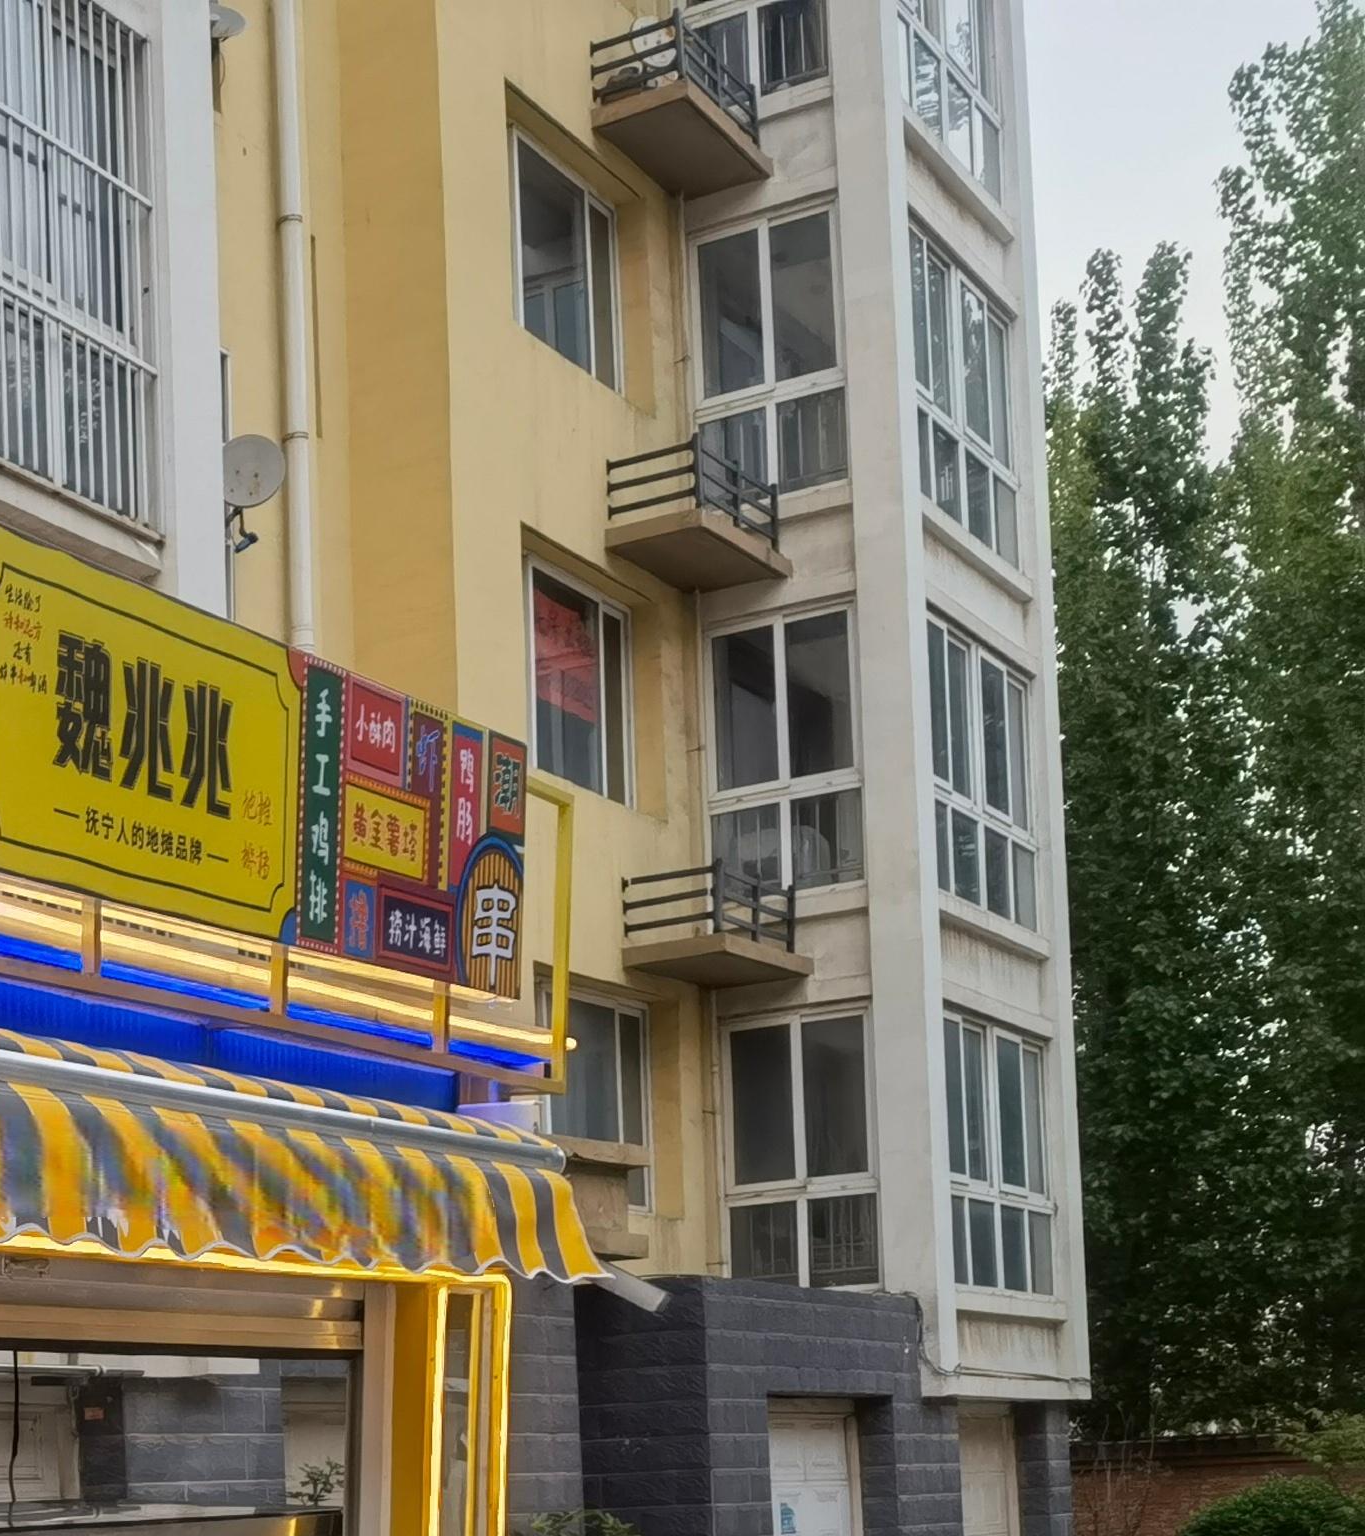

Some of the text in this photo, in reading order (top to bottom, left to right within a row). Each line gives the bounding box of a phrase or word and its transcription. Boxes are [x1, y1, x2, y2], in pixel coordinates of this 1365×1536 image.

[53, 629, 233, 820] 魏兆兆
[355, 703, 396, 753] 小酥肉
[416, 724, 441, 793] 虾
[85, 806, 203, 866] 抚宁人的地摊品牌
[309, 688, 333, 924] 手工鸡排
[352, 801, 417, 862] 黄金薯塔
[388, 908, 446, 959] 捞汁海鲜
[471, 880, 518, 988] 串
